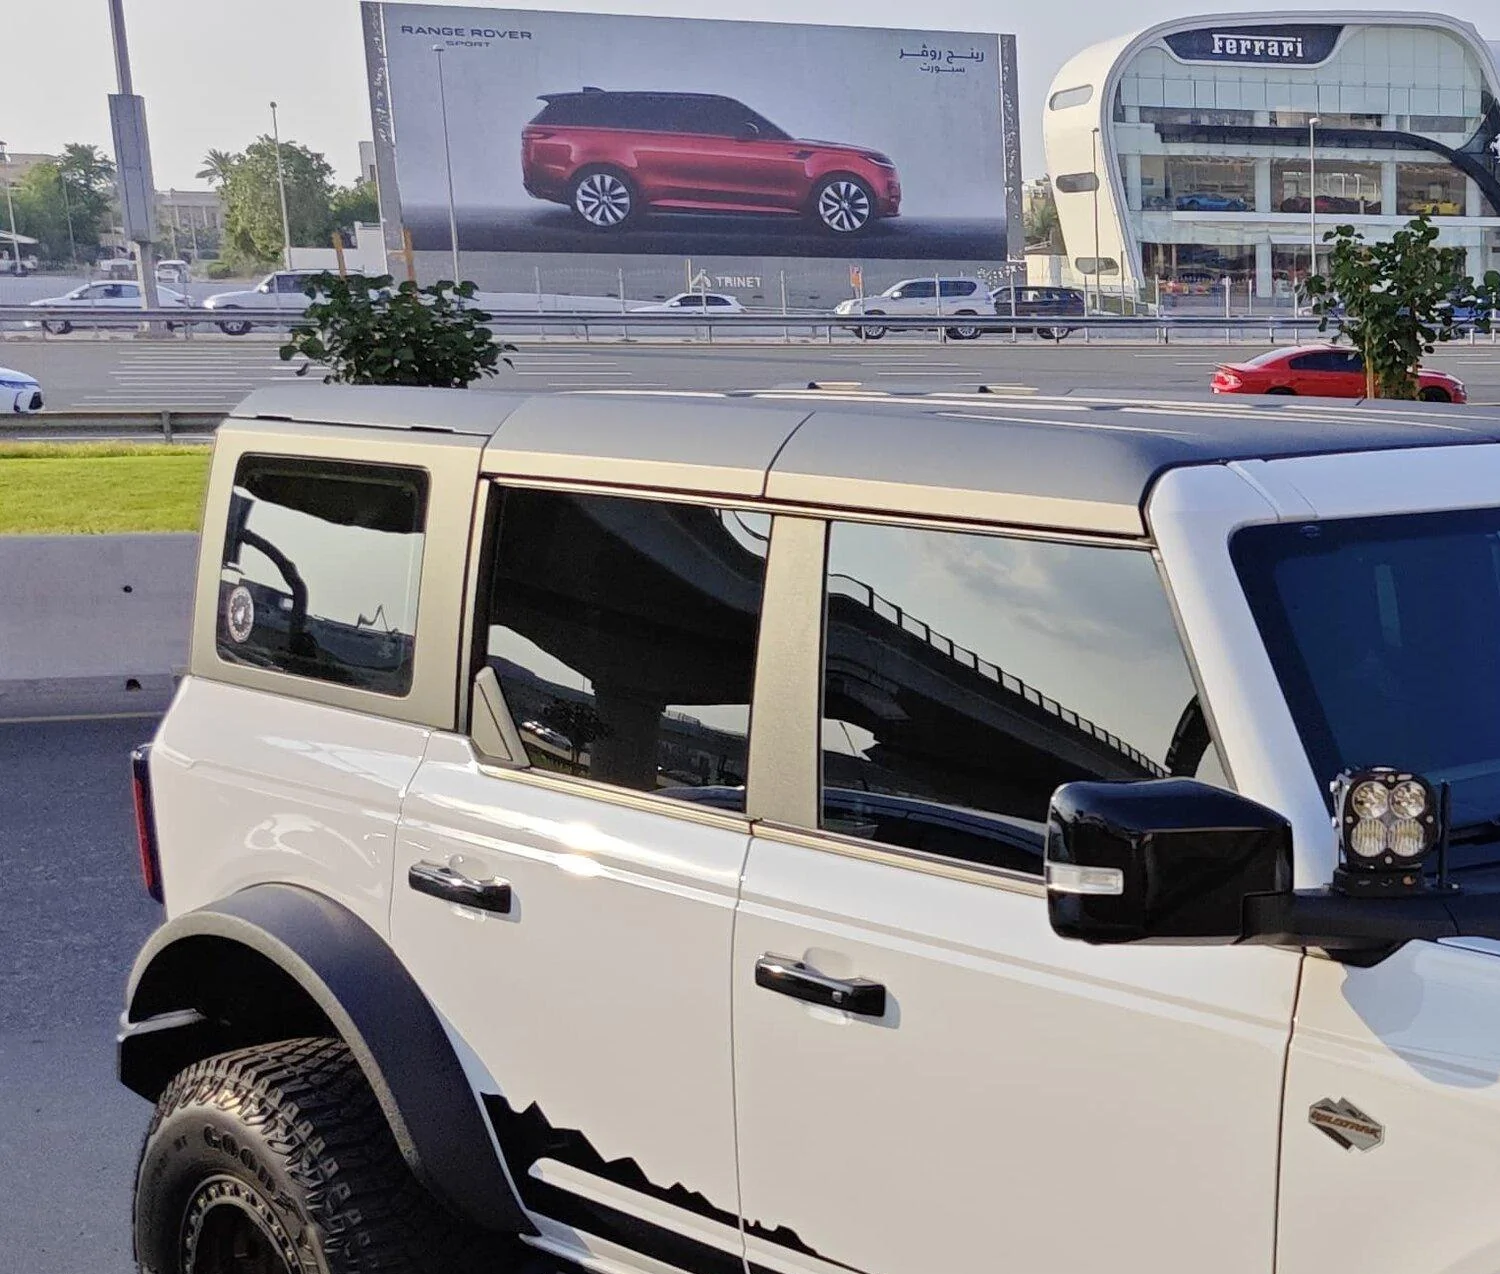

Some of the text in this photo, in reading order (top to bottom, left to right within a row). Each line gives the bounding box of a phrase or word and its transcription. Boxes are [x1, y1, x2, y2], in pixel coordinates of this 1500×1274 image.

[400, 25, 533, 40] RANGE ROVER
[445, 40, 491, 48] SPORT
[1211, 33, 1304, 57] Ferrari
[945, 47, 985, 64] رينج
[715, 276, 762, 288] TRINET
